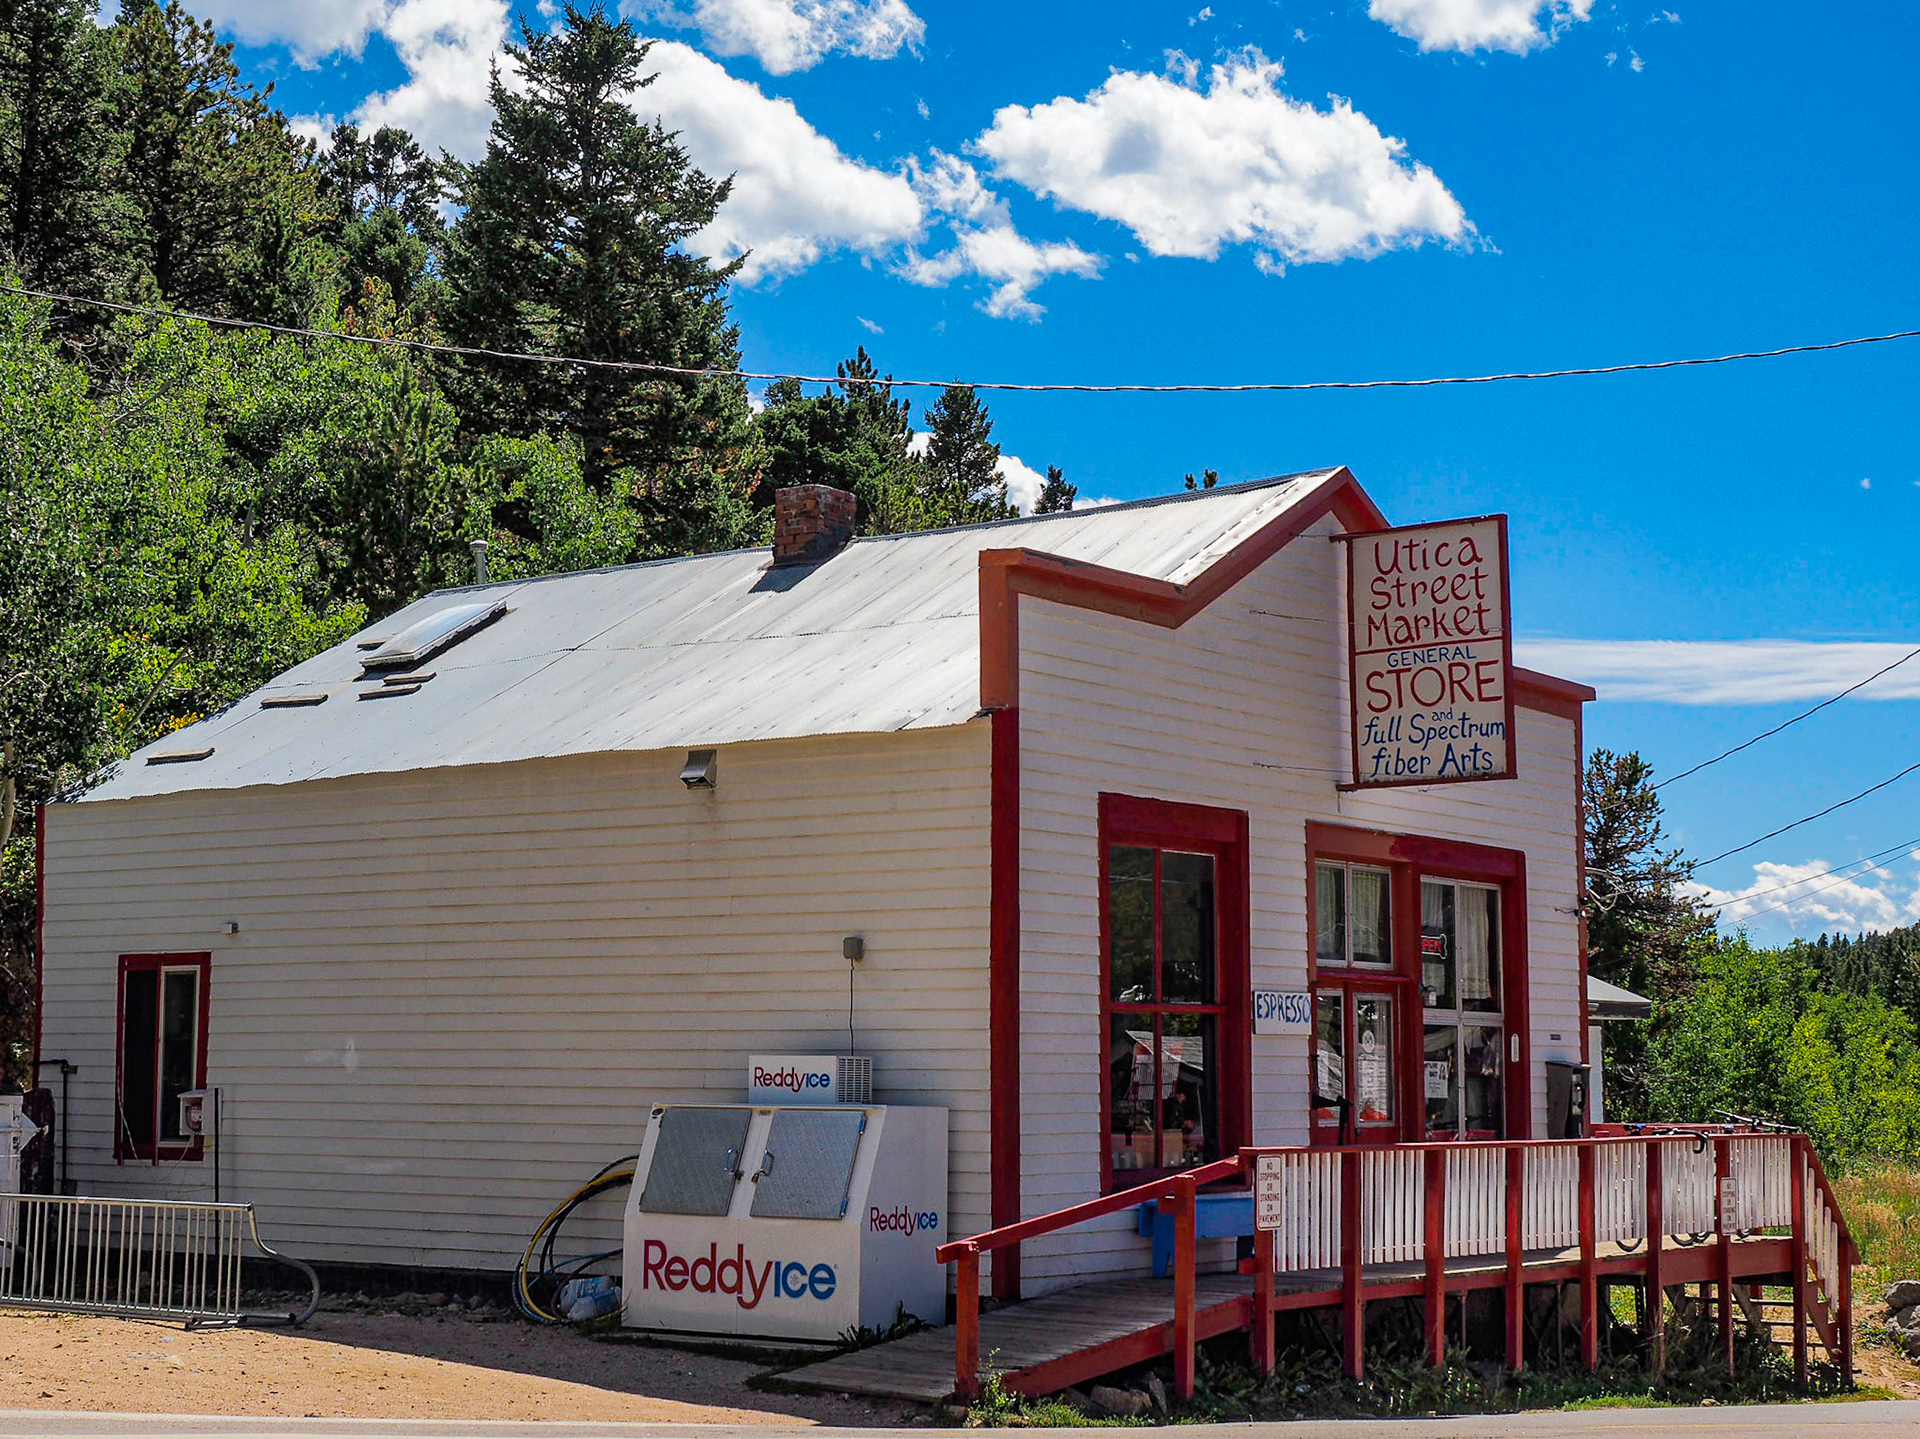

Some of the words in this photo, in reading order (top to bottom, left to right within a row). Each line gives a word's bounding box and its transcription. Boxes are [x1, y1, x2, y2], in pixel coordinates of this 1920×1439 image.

[1374, 536, 1484, 576] Utica
[1370, 566, 1490, 611] Street
[1367, 601, 1492, 648] Market
[1387, 645, 1477, 668] GENERAL
[1365, 659, 1503, 713] STORE
[1431, 707, 1454, 722] and
[1360, 716, 1403, 747] full
[1408, 711, 1506, 751] Spectrum
[1370, 746, 1431, 778] fiber
[1437, 742, 1494, 777] Arts
[1421, 939, 1442, 952] PEN
[1256, 993, 1312, 1023] ESPRESSO
[1260, 1172, 1280, 1182] STOPPING
[1266, 1162, 1273, 1170] NO
[1260, 1193, 1280, 1203] STANDING
[1260, 1214, 1280, 1223] PAVEMENT
